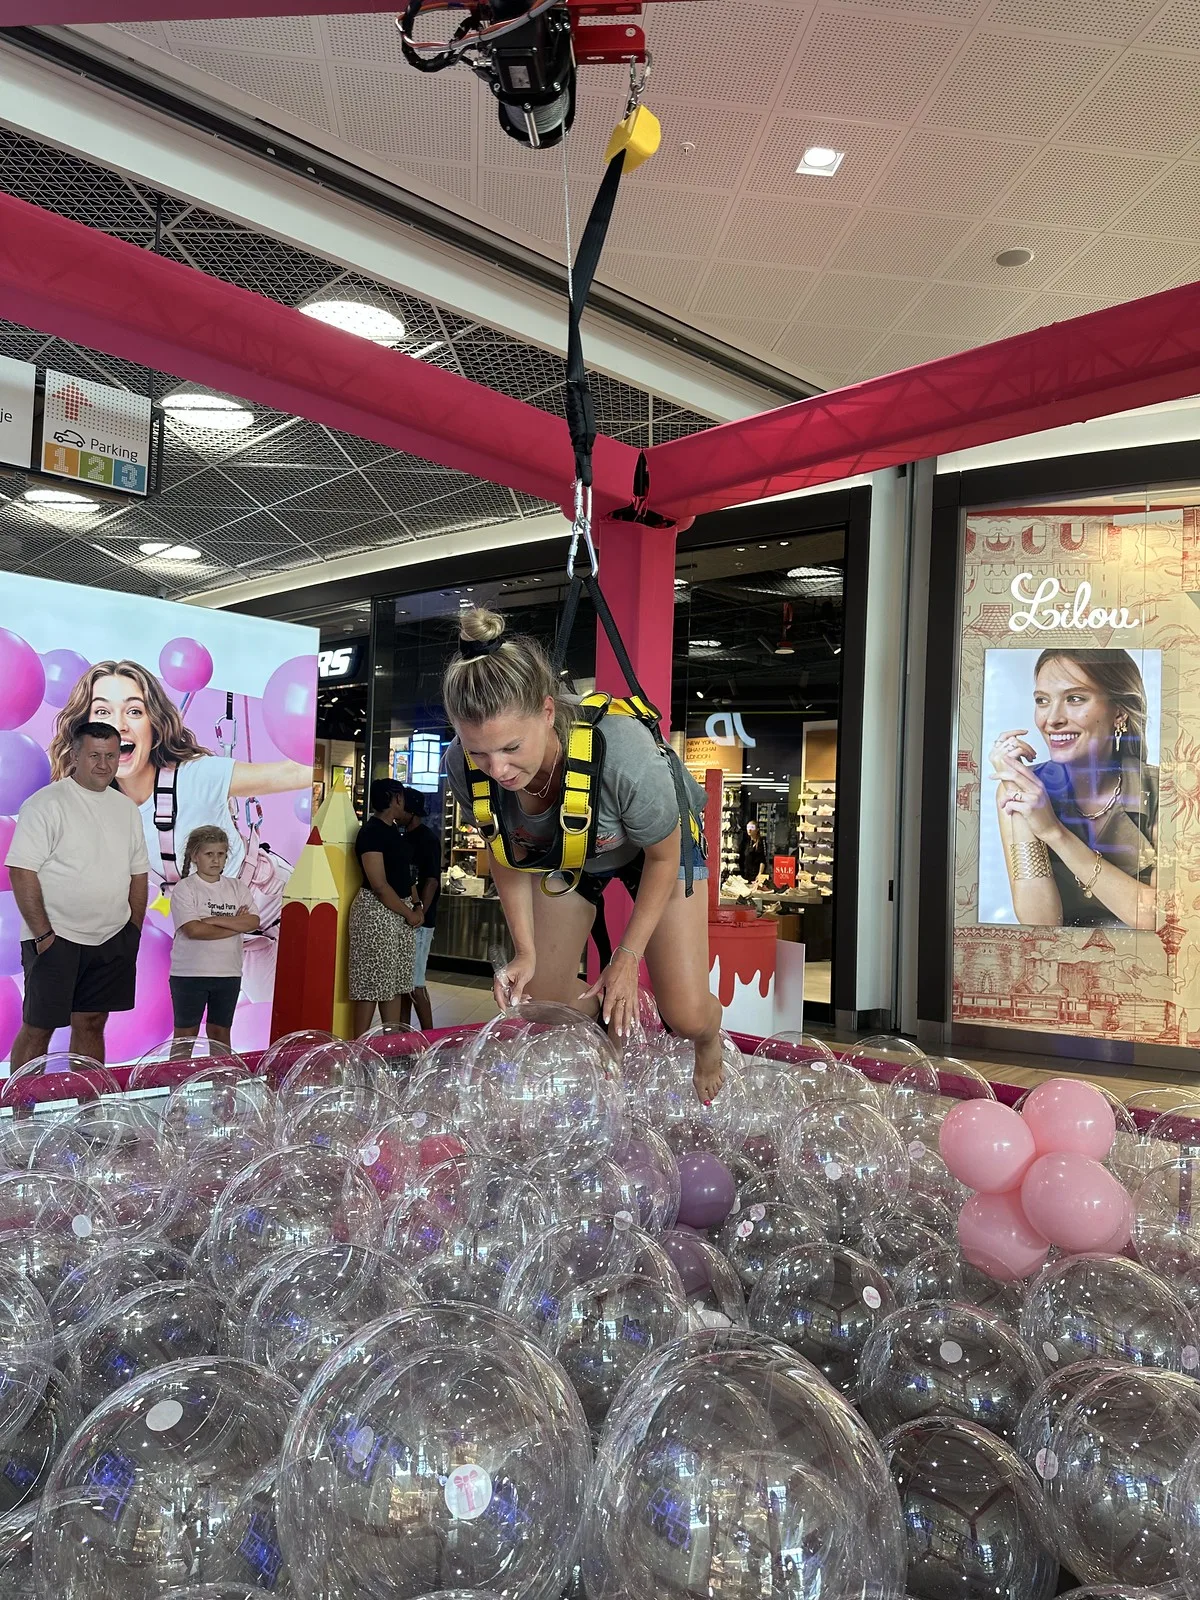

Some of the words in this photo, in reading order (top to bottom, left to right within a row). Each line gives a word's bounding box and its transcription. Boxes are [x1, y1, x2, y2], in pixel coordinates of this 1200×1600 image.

[90, 438, 138, 463] Parking
[54, 447, 69, 473] 1
[87, 455, 105, 481] 2
[121, 463, 138, 488] 3
[1008, 572, 1139, 632] Lilou
[775, 866, 794, 874] SALE
